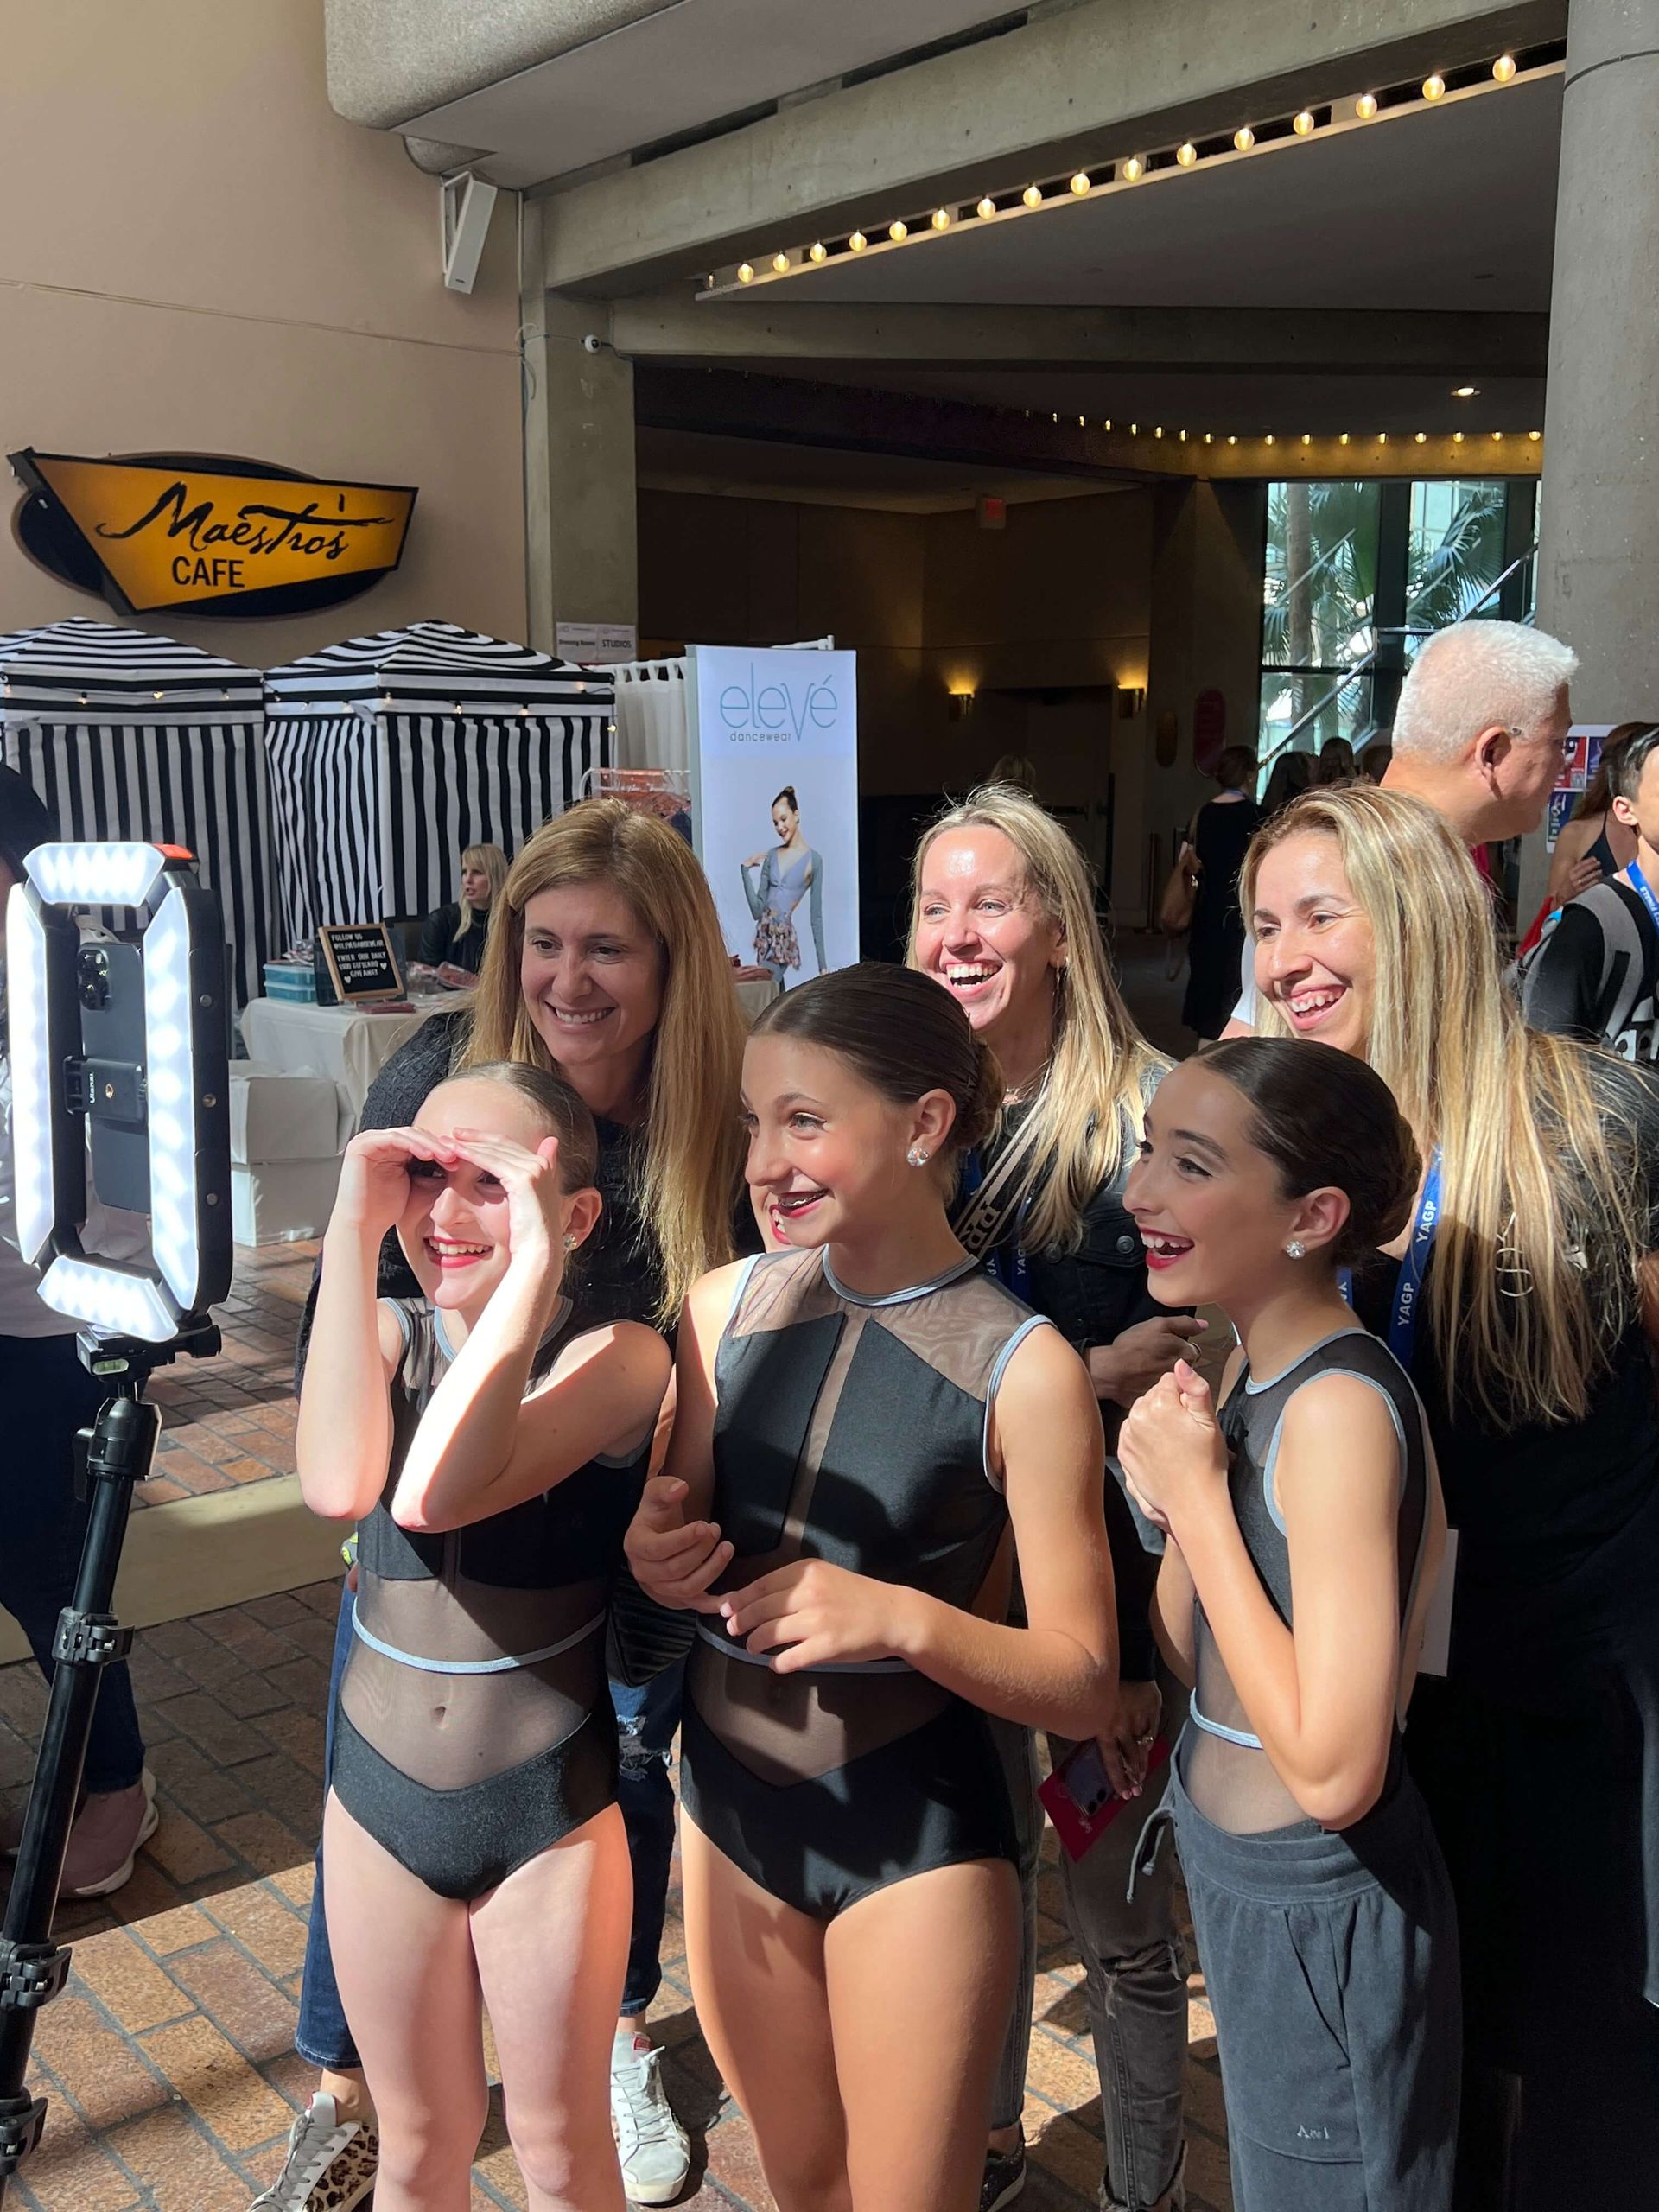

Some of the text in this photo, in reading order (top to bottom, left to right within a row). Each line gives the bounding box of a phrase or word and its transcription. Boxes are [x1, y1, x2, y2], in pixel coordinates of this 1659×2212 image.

[172, 556, 245, 588] CAFE
[601, 639, 632, 648] STUDIOS
[730, 732, 791, 742] dancewear
[1415, 1200, 1437, 1243] YAGP
[1397, 1281, 1414, 1326] YAGP
